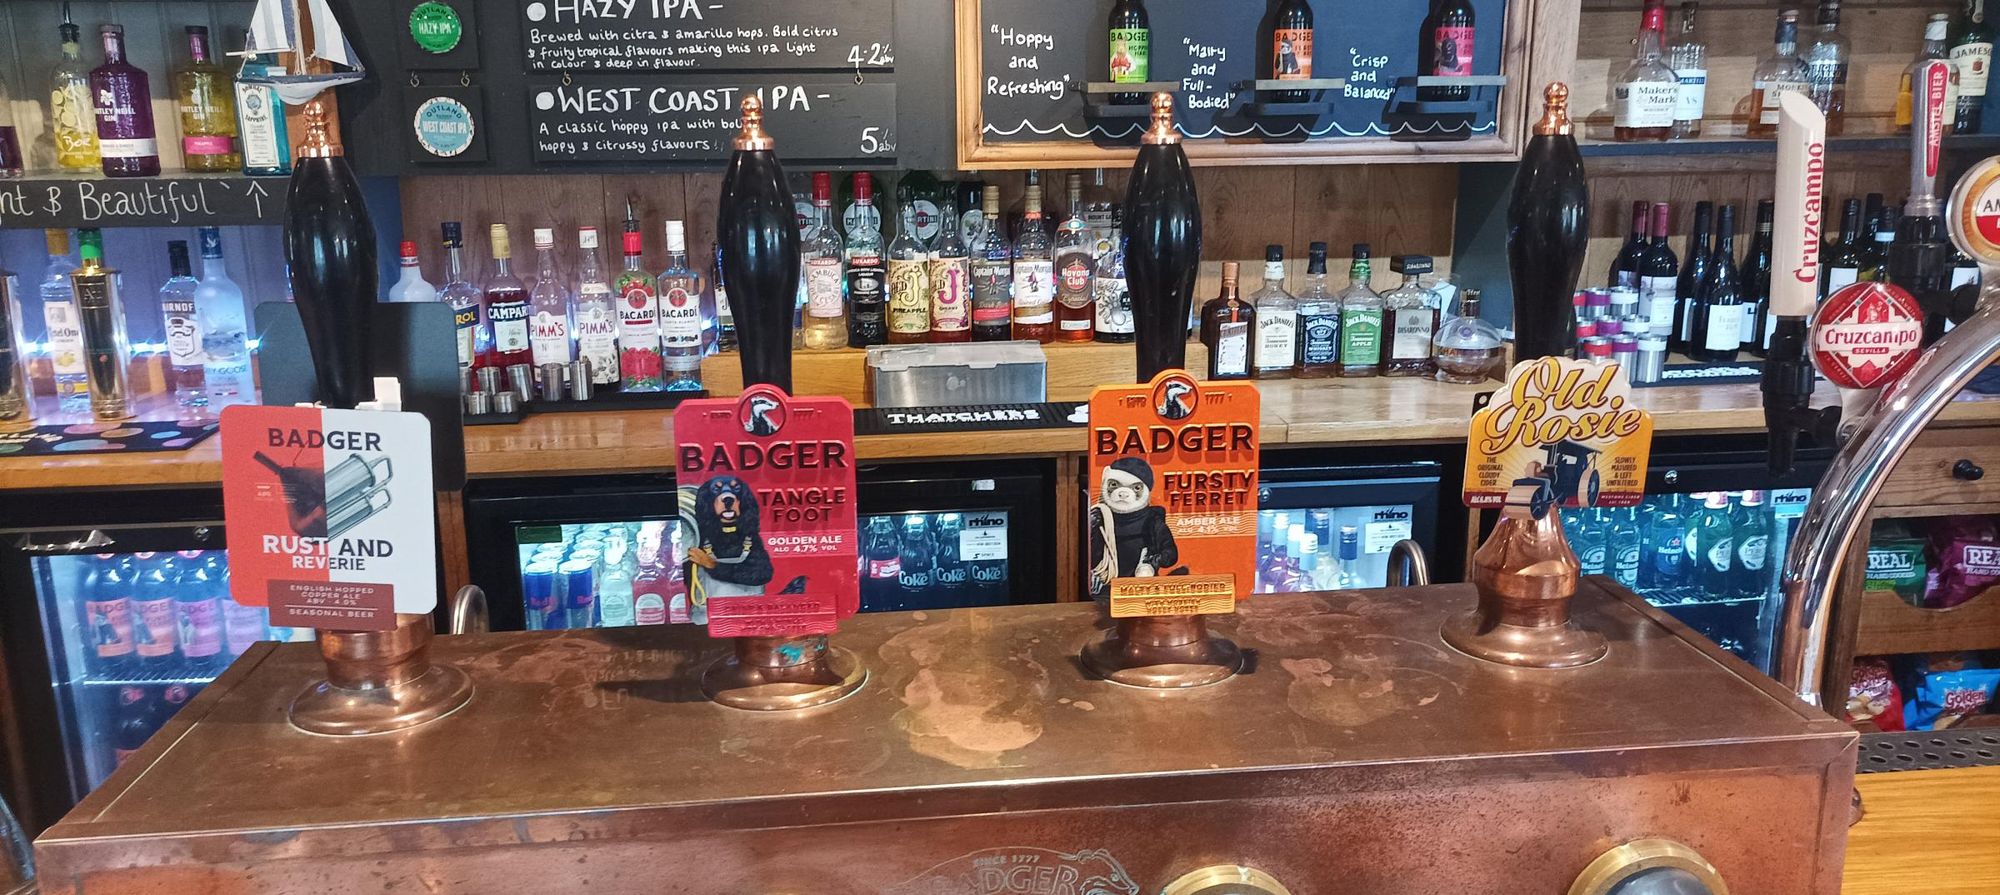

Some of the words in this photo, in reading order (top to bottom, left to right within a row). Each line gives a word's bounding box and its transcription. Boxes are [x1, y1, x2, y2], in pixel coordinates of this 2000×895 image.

[531, 29, 584, 43] Brewed
[588, 29, 619, 41] with
[623, 28, 657, 40] citra
[675, 27, 733, 40] amarillo
[773, 25, 799, 37] Bold
[802, 26, 838, 37] citrus
[1275, 32, 1312, 41] BADGE
[577, 44, 623, 58] tropical
[624, 46, 673, 58] flavours
[678, 43, 722, 57] making
[727, 42, 750, 53] this
[758, 44, 780, 55] ipa
[533, 59, 545, 69] in
[606, 58, 633, 70] deep
[637, 58, 649, 68] in
[1008, 56, 1038, 69] and
[1191, 63, 1216, 76] and
[1351, 71, 1377, 82] and
[1932, 71, 1943, 99] BIER
[557, 86, 641, 114] WEST
[649, 87, 740, 114] COAST
[757, 85, 810, 111] IPA
[1648, 95, 1677, 104] Mark
[426, 105, 462, 119] OUTLAND
[423, 121, 438, 133] WEST
[440, 121, 457, 133] COAST
[539, 123, 549, 135] A
[557, 120, 606, 134] classic
[611, 119, 648, 135] hoppy
[657, 121, 680, 132] ipa
[687, 117, 715, 129] with
[1929, 102, 1943, 146] AMSTEL
[539, 140, 575, 154] hoppy
[596, 140, 646, 154] citrussy
[1793, 142, 1823, 283] Cruzcampo
[1067, 277, 1085, 286] Club
[488, 305, 530, 319] CAMPAR
[1825, 329, 1917, 346] Cruzcampo
[1511, 356, 1621, 411] Old
[1480, 395, 1642, 455] Rosie
[268, 428, 382, 451] BADGER
[1095, 423, 1255, 455] BADGER
[679, 440, 849, 472] BADGER
[1163, 470, 1255, 490] FURSTY
[757, 487, 846, 507] TANGLE
[1170, 488, 1250, 507] FERRET
[773, 507, 833, 523] FOOT
[968, 514, 1004, 527] rhino
[1177, 517, 1217, 527] AMBER
[1219, 516, 1240, 525] ALE
[1374, 507, 1409, 520] rhino
[262, 535, 329, 555] RUST
[338, 538, 394, 557] AND
[767, 536, 818, 546] GOLDEN
[819, 535, 842, 544] ALE
[292, 555, 366, 571] REVERIE
[1868, 553, 1911, 569] REAL
[1968, 548, 2000, 566] REA
[900, 570, 929, 586] Coke
[936, 567, 966, 583] Coke
[972, 565, 1001, 580] Coke
[290, 584, 332, 592] ENGLISH
[289, 608, 345, 617] SEASONAL
[1945, 690, 1986, 708] Golden
[1011, 855, 1040, 864] 1777
